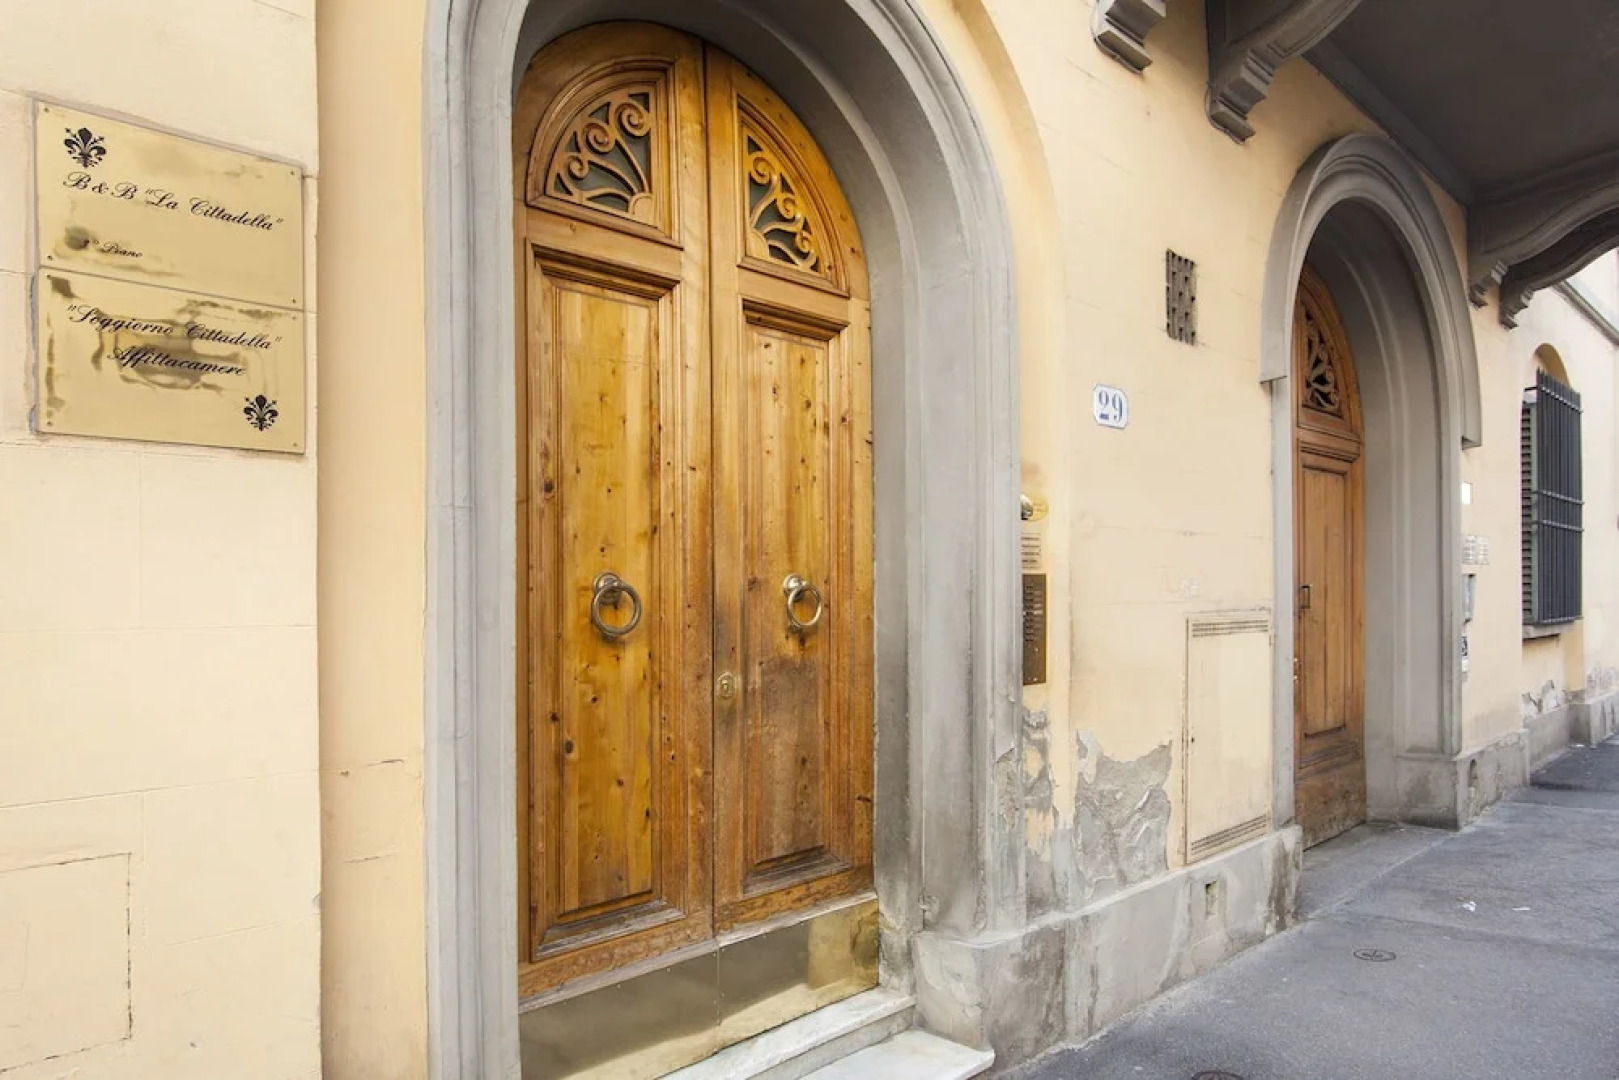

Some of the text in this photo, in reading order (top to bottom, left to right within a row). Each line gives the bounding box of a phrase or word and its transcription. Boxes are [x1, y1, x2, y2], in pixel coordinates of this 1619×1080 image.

[63, 171, 91, 190] B
[91, 181, 110, 194] &
[110, 182, 138, 200] B
[107, 345, 247, 376] Affittacamere
[1099, 390, 1123, 421] 29
